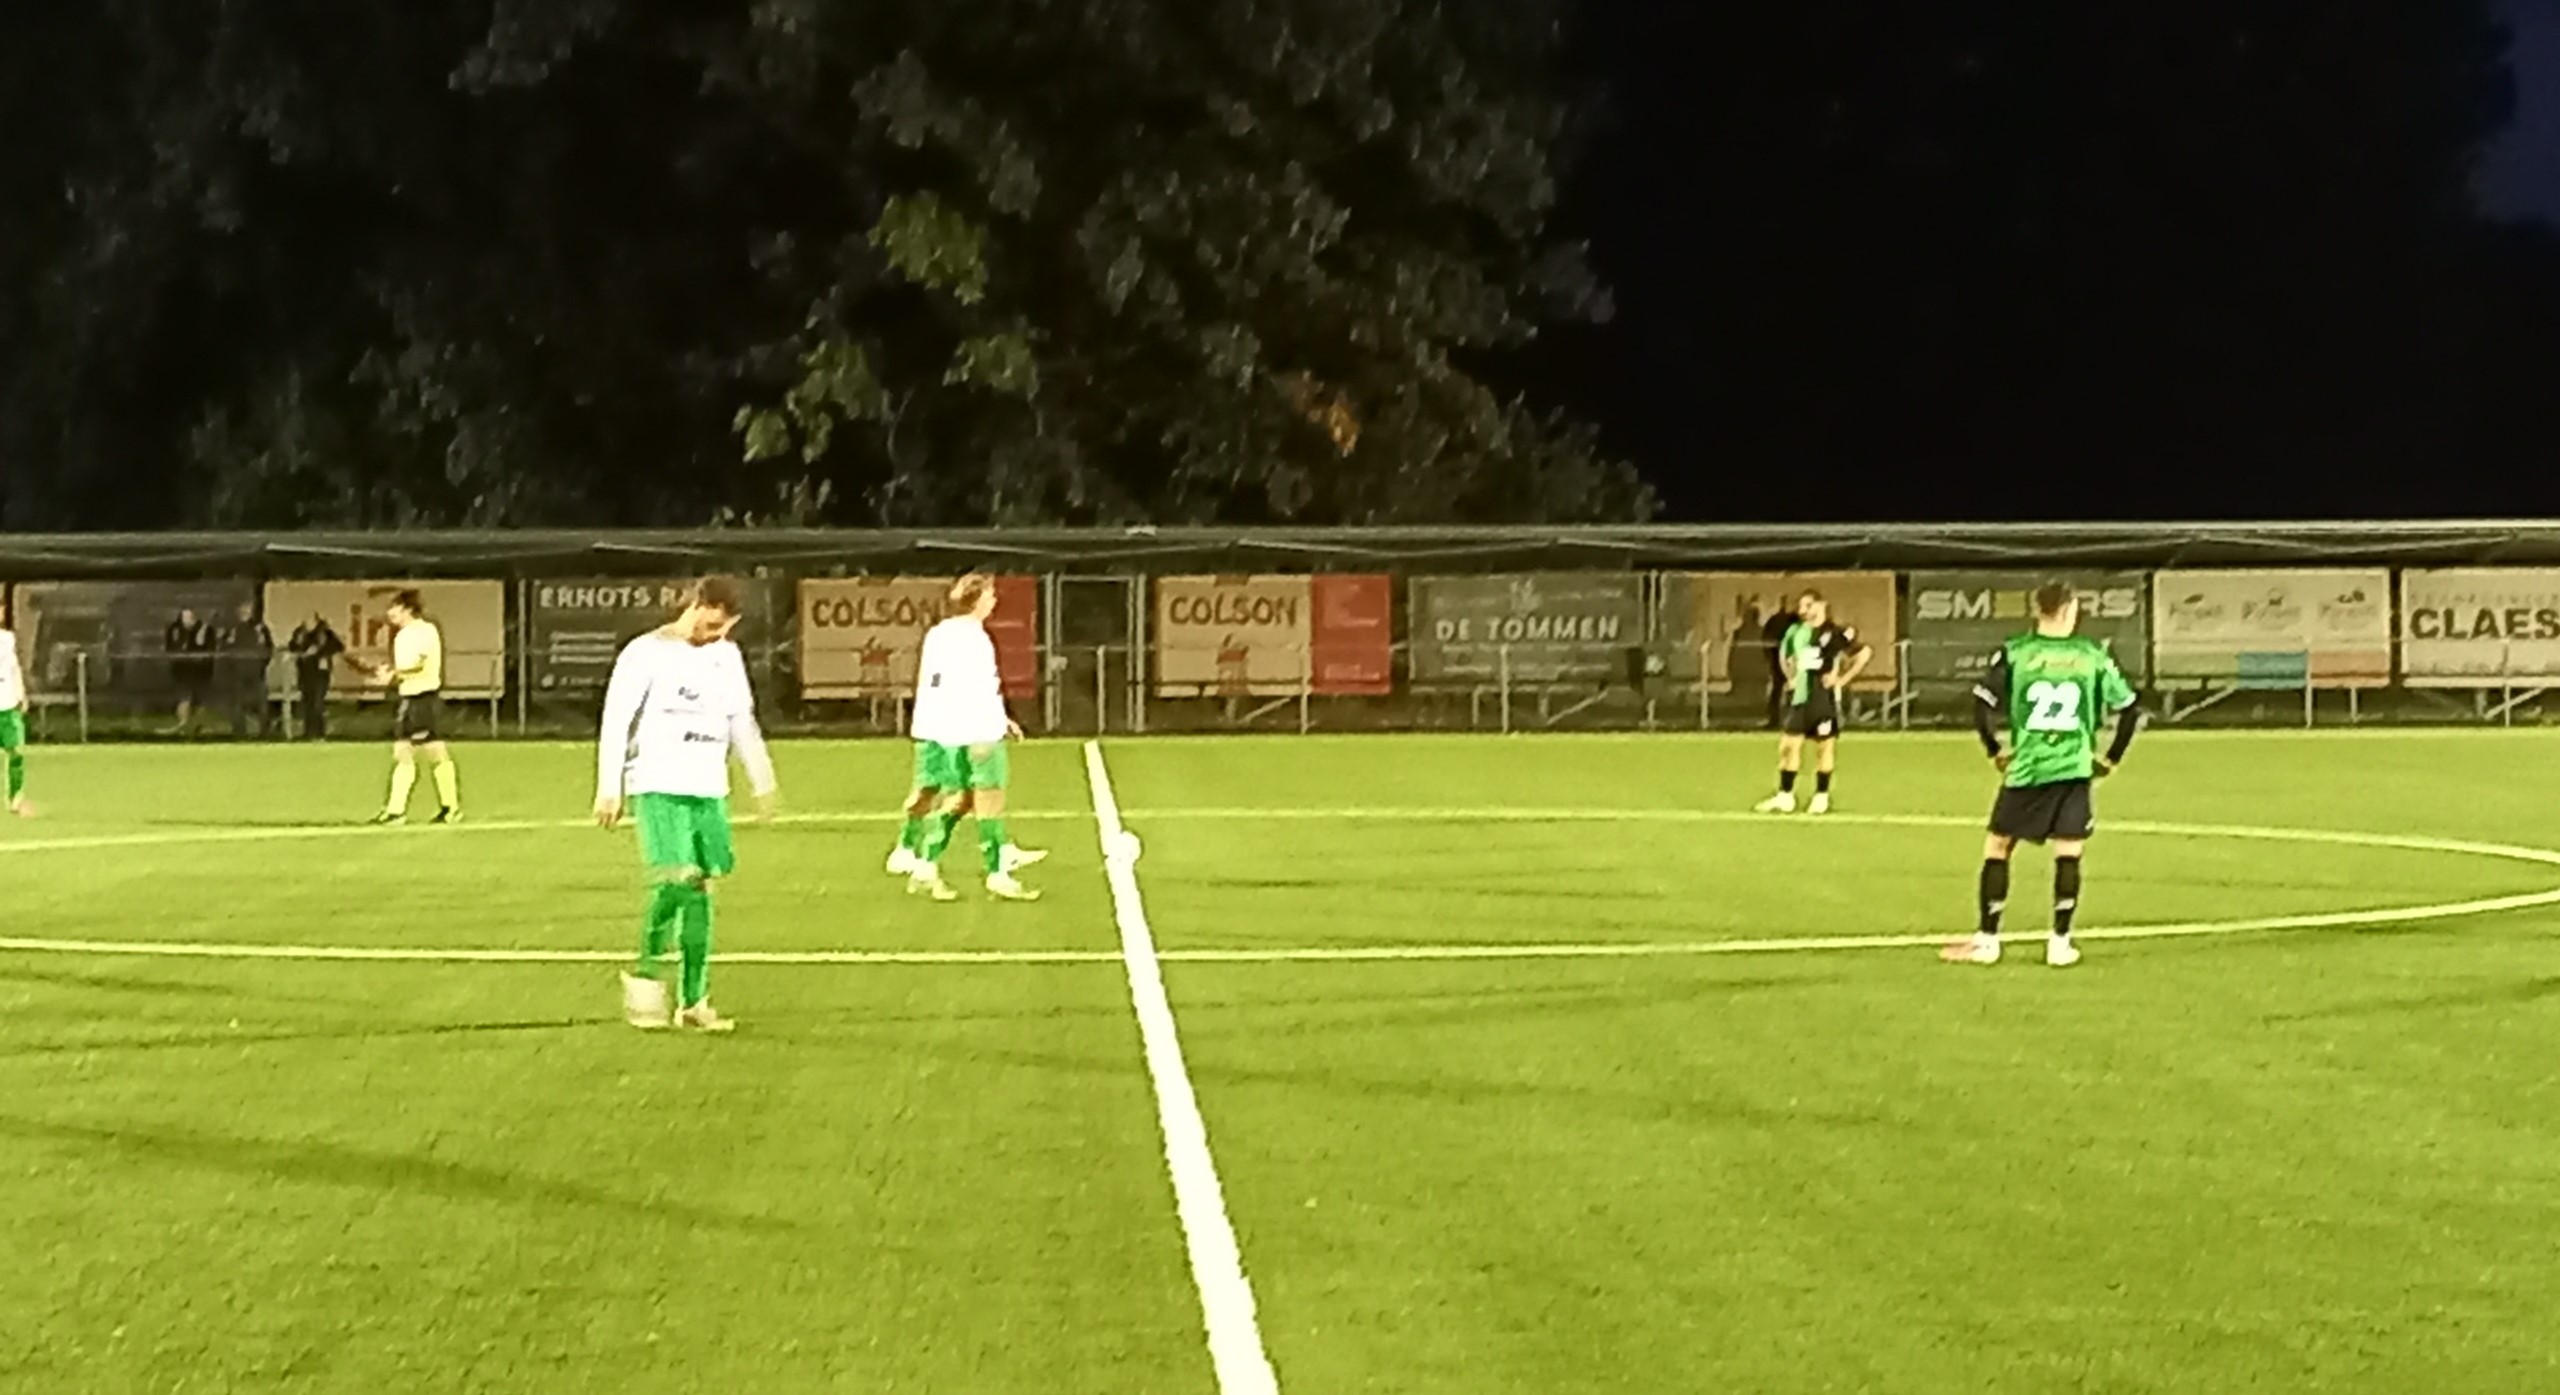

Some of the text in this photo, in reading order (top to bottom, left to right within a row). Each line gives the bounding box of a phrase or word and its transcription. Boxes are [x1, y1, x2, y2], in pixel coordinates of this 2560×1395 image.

[1169, 595, 1297, 626] COLSON
[1917, 590, 2137, 619] SMERS
[1436, 616, 1619, 640] DE TOMMEN
[2410, 608, 2560, 640] CLAES
[2026, 680, 2080, 731] 22
